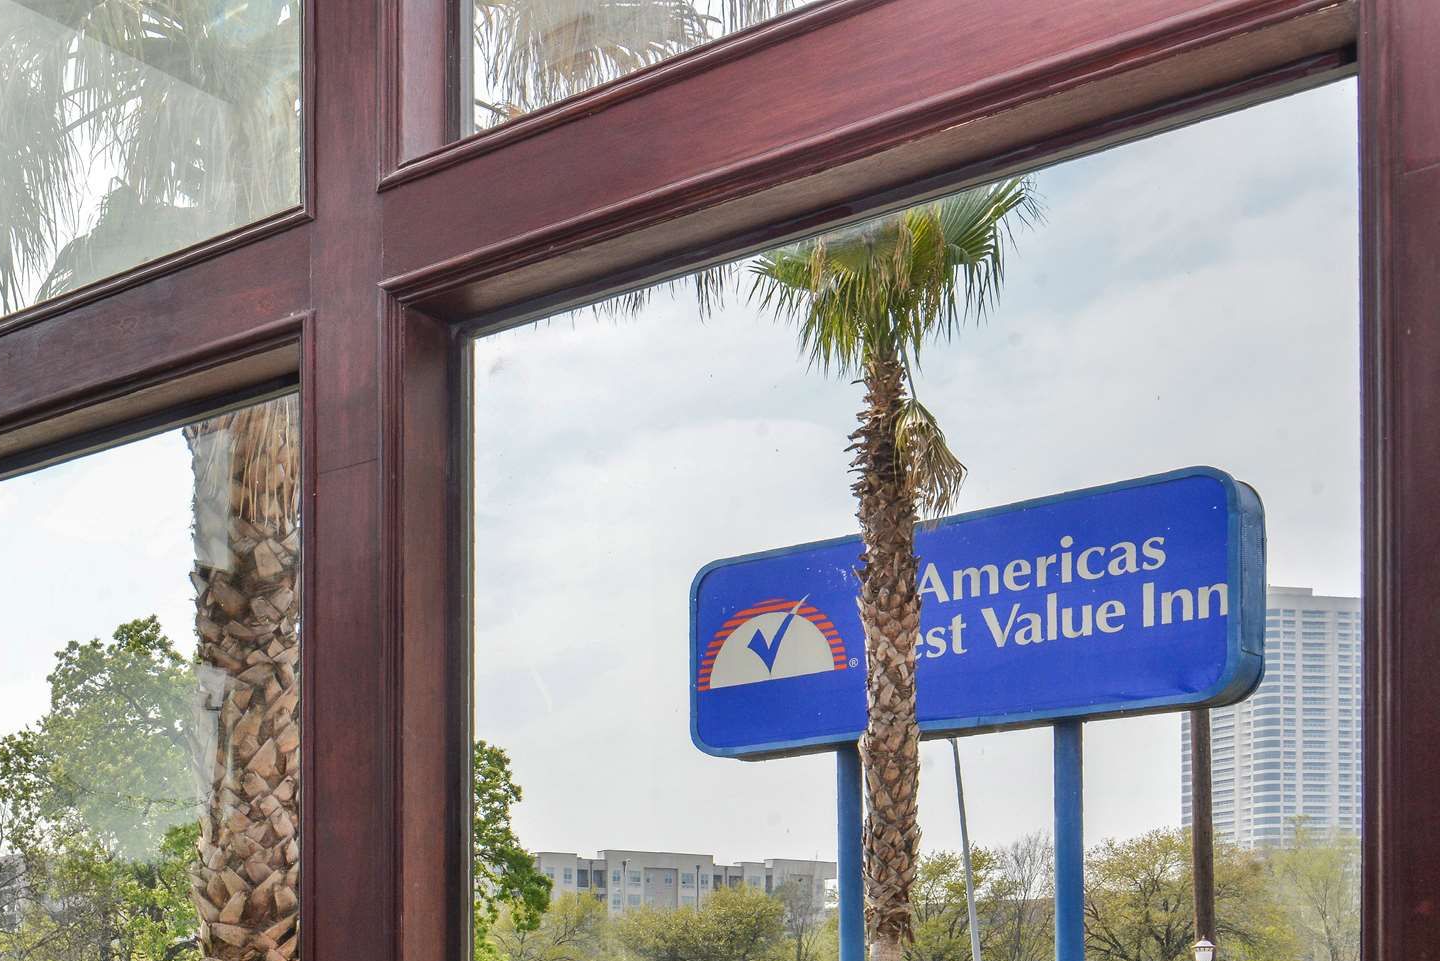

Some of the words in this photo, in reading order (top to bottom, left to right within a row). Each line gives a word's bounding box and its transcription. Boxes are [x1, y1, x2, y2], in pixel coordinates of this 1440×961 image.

[917, 535, 1167, 603] Americas
[981, 593, 1126, 648] Value
[1142, 582, 1229, 628] Inn
